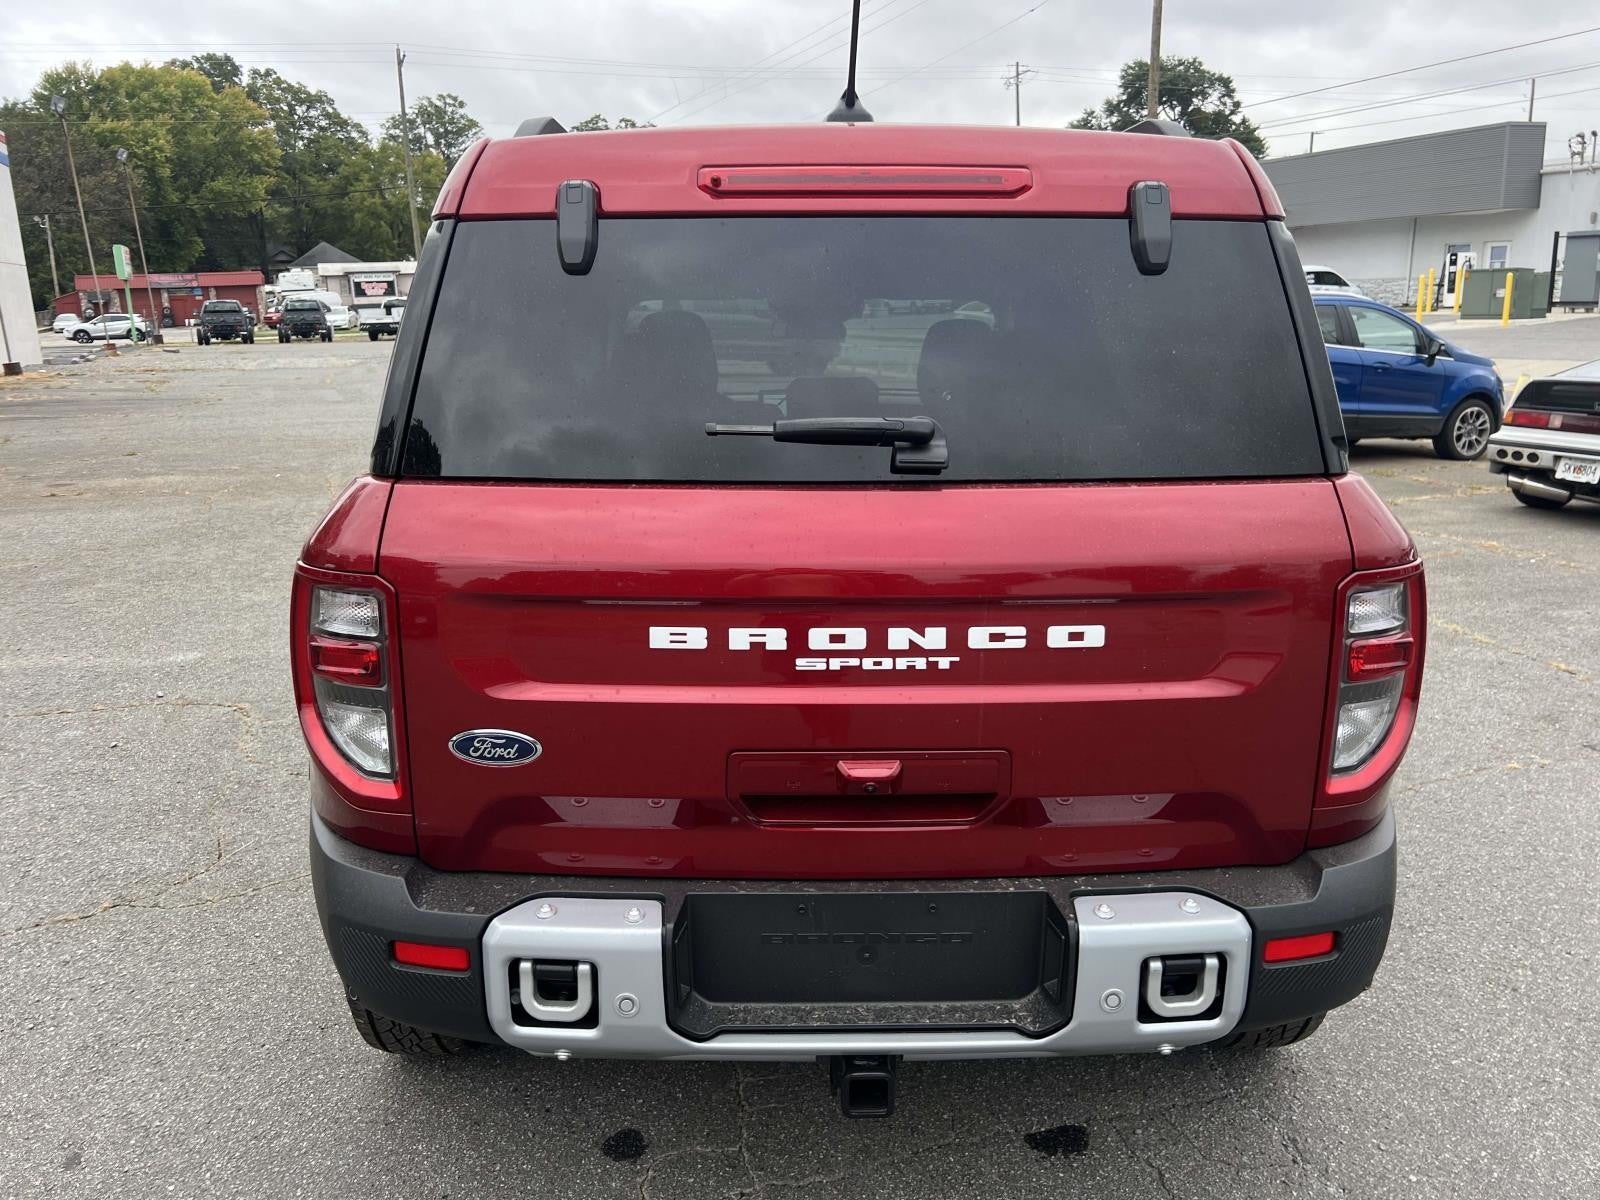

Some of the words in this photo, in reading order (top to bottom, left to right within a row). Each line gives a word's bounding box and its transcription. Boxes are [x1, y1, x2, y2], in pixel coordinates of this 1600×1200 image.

[649, 625, 1106, 650] BRONCO
[795, 656, 960, 671] SPORT
[469, 737, 519, 758] Ford
